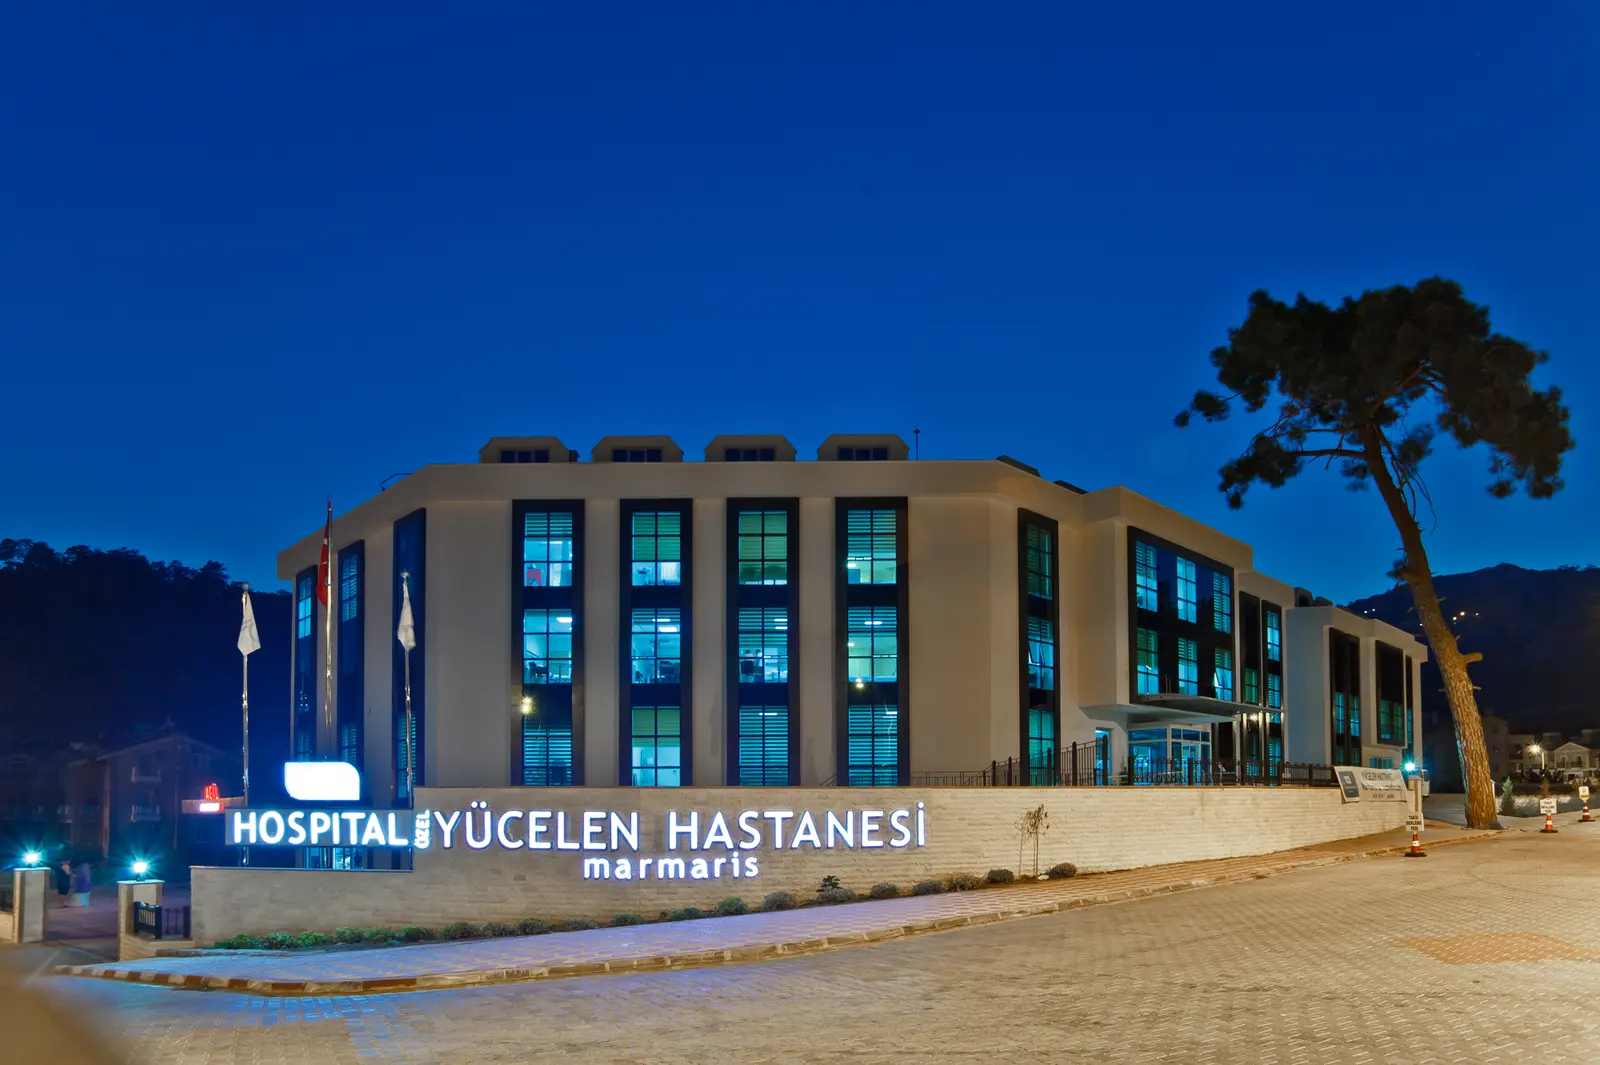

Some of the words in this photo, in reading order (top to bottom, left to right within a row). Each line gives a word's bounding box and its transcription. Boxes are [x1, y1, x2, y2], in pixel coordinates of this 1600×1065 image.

[233, 811, 409, 846] HOSPITAL
[413, 809, 430, 849] ÖZEL
[433, 801, 639, 851] YÜCELEN
[668, 801, 926, 850] HASTANESİ
[583, 851, 760, 881] marmaris
